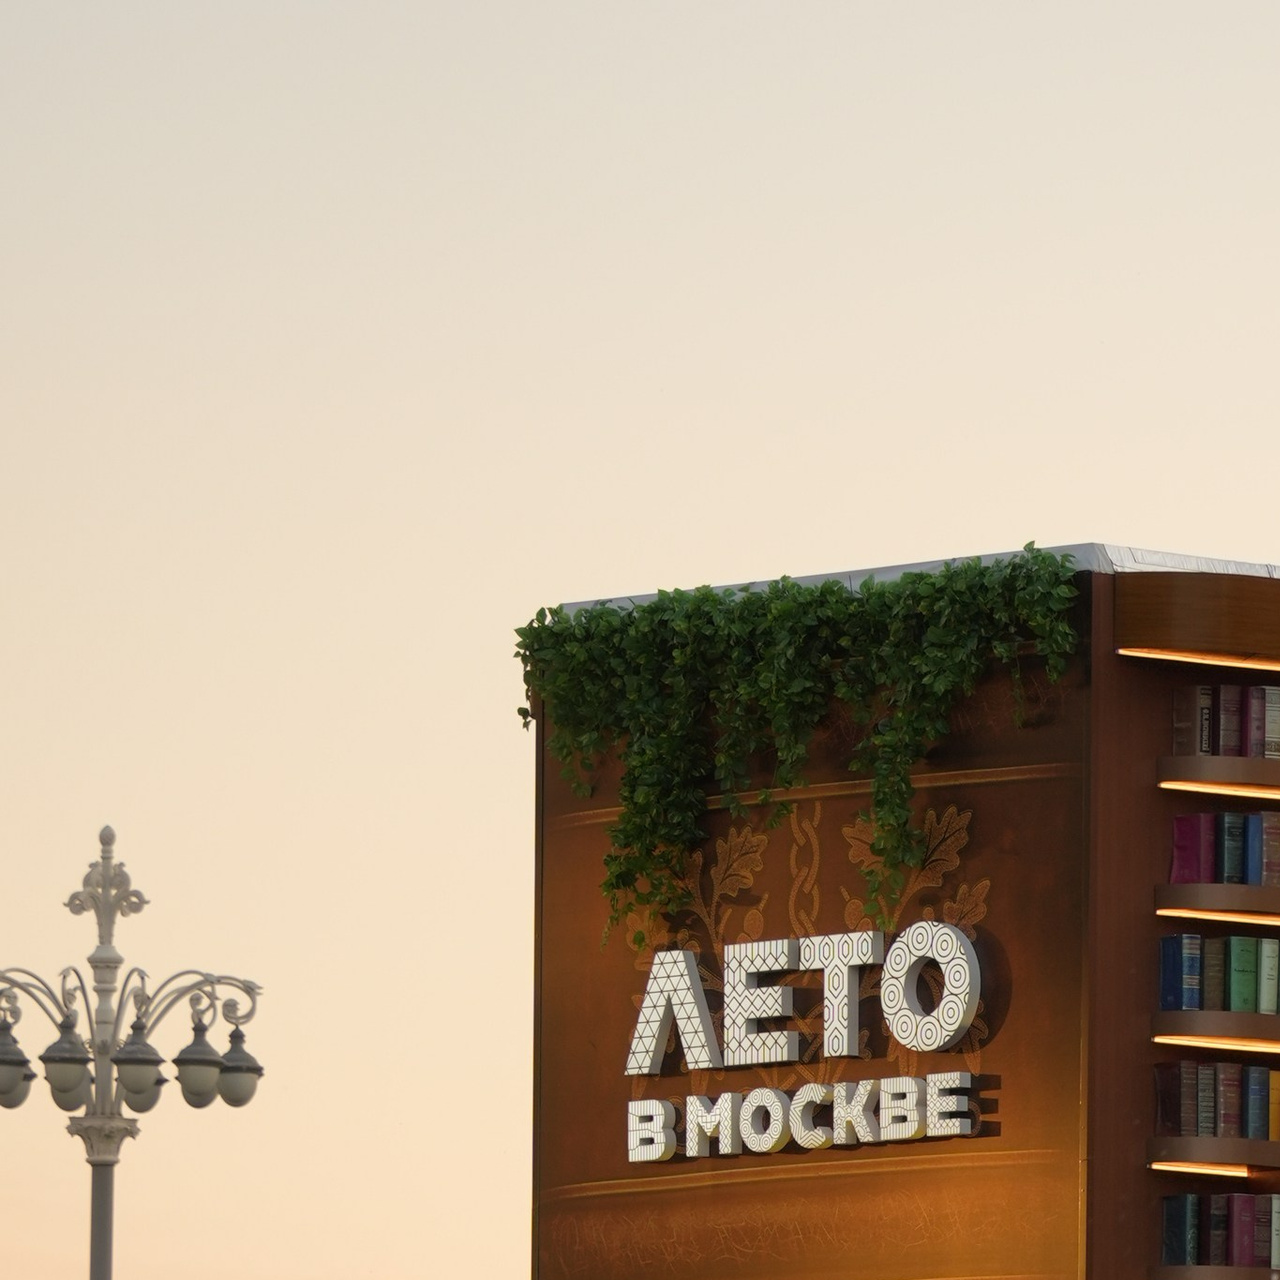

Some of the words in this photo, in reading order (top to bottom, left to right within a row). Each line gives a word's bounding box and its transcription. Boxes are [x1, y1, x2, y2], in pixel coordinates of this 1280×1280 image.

[625, 921, 981, 1075] ЛЕТО
[628, 1099, 676, 1162] В
[686, 1072, 972, 1158] МОСКВЕ
